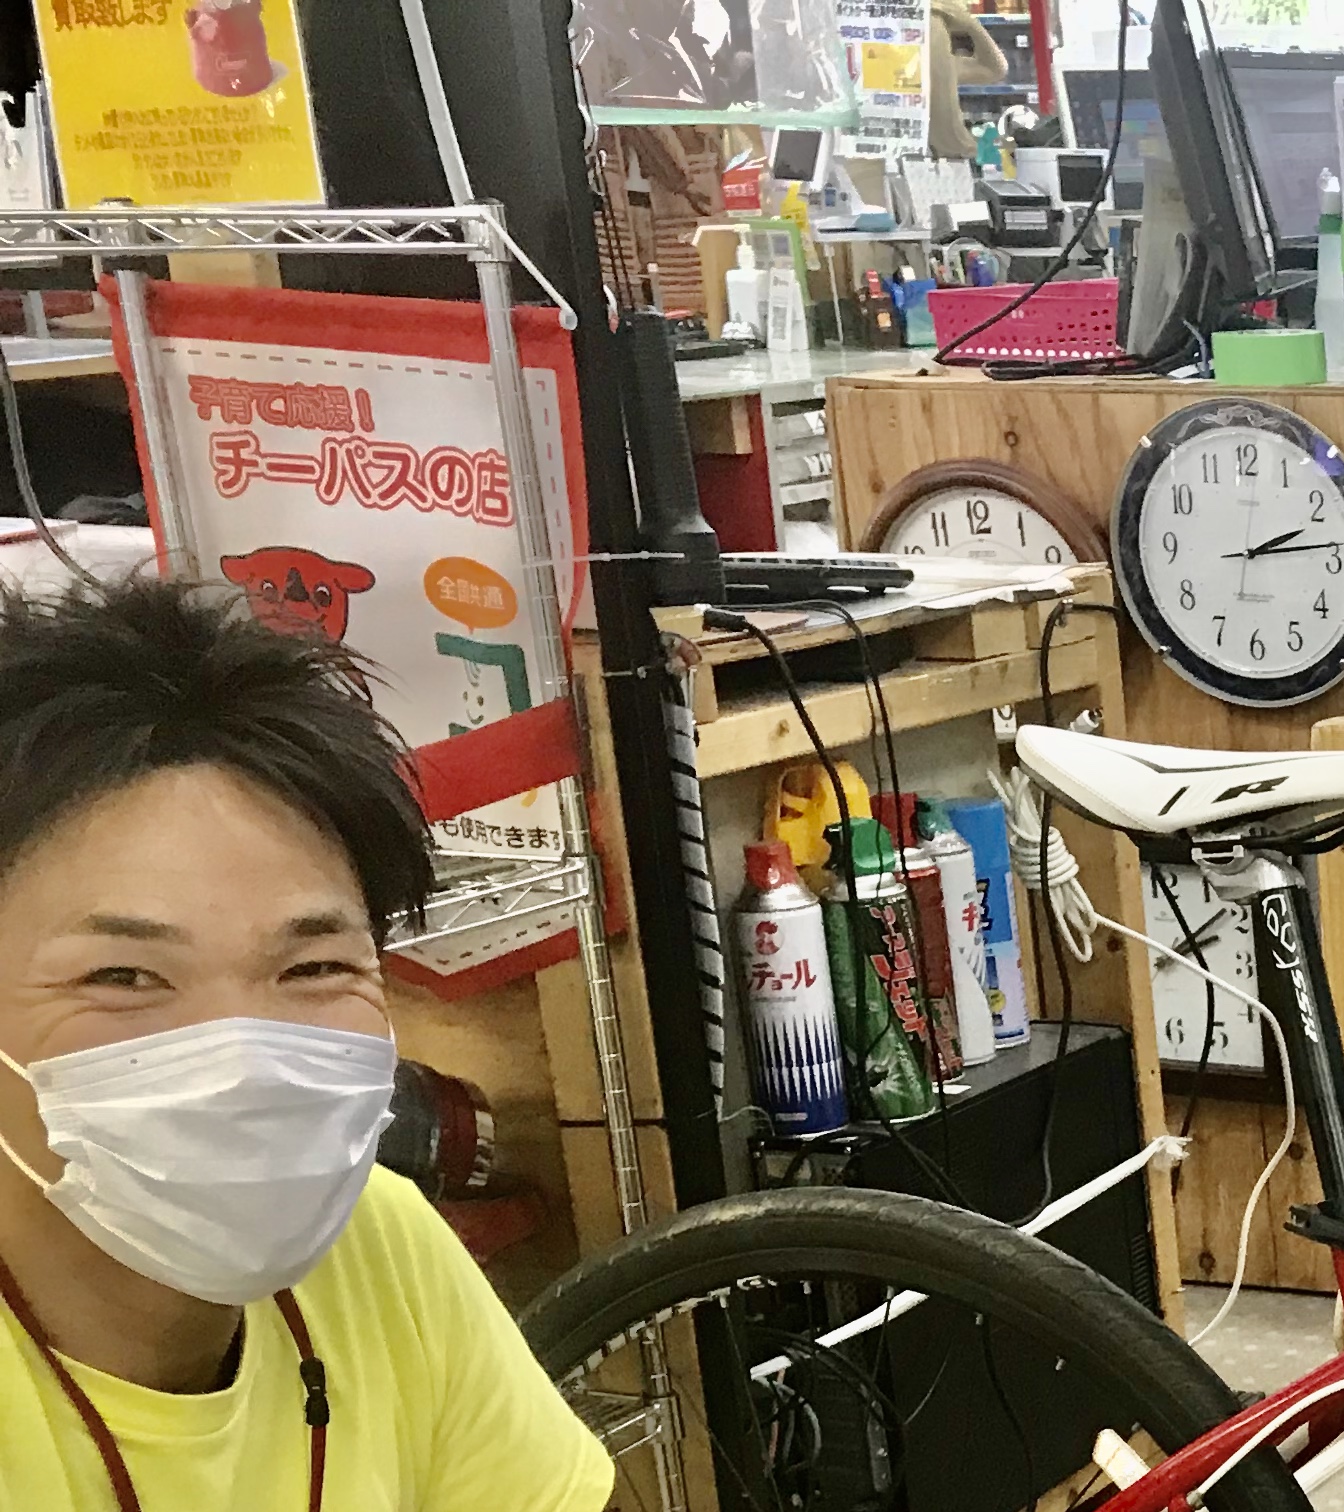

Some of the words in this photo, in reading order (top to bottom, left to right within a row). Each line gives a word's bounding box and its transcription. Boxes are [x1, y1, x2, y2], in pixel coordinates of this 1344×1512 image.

[1201, 452, 1220, 484] 11
[1235, 443, 1258, 477] 12
[1281, 458, 1289, 488] 1
[209, 430, 514, 524] チーパスの店
[1172, 483, 1193, 515] 10
[1309, 490, 1326, 523] 2
[931, 511, 950, 547] 11
[967, 500, 991, 535] 12
[1017, 511, 1026, 546] 1
[1163, 532, 1178, 565] 9
[1325, 541, 1343, 575] 3
[1180, 579, 1196, 610] 8
[1313, 588, 1329, 619] 4
[1212, 616, 1226, 647] 7
[1249, 628, 1265, 660] 6
[1287, 621, 1303, 653] 5
[1232, 901, 1251, 934] 2
[1234, 951, 1254, 979] 3
[1165, 1017, 1185, 1047] 6
